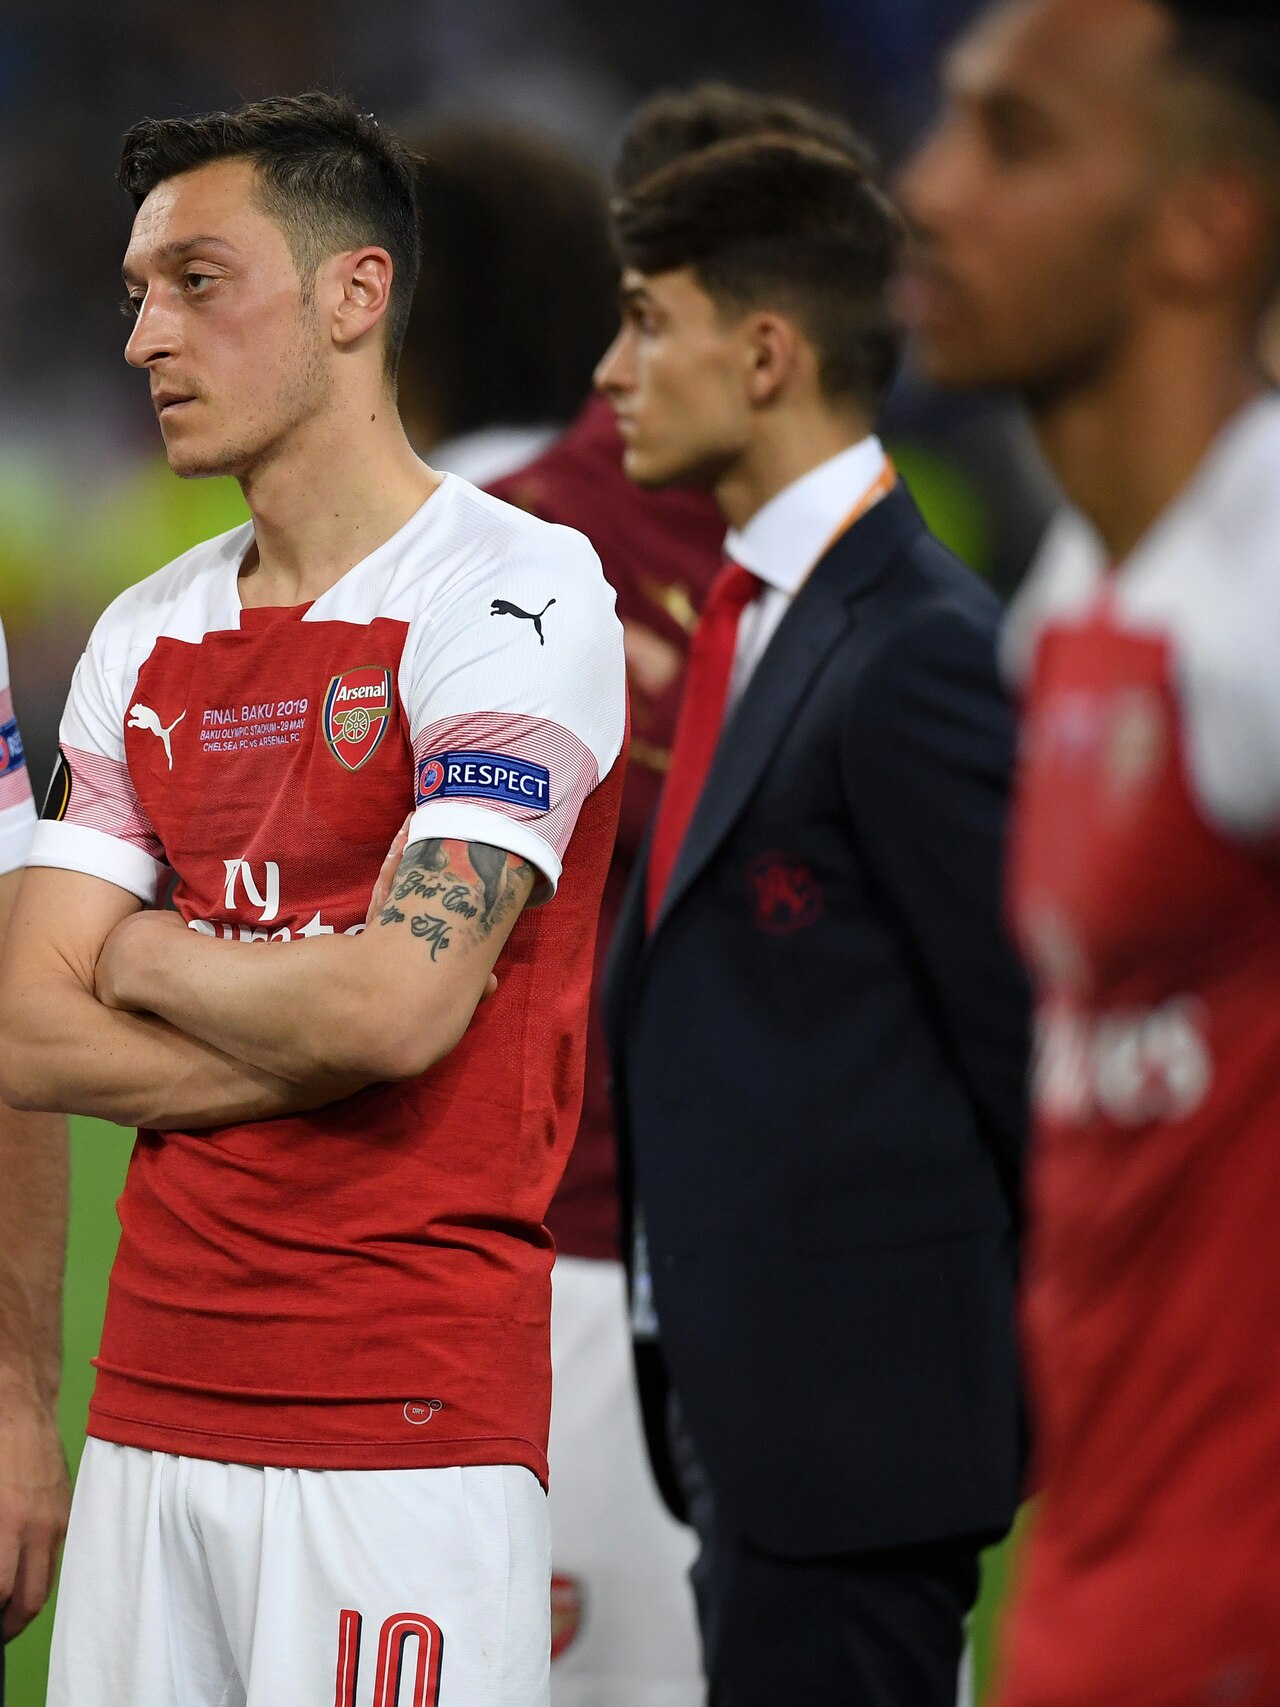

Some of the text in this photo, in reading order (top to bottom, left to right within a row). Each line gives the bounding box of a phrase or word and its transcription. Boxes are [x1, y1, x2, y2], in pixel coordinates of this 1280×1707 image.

[335, 680, 386, 703] Arsenal
[202, 698, 309, 726] FINAL BAKU 2019
[199, 729, 221, 741] BAKU
[222, 725, 249, 739] OLYMPIC
[289, 718, 306, 731] MAY
[202, 740, 239, 753] CHELSEA
[239, 738, 249, 750] FC
[258, 735, 290, 747] ARSENAL
[290, 732, 301, 742] FC
[447, 763, 548, 798] RESPECT
[411, 1407, 425, 1415] DRY
